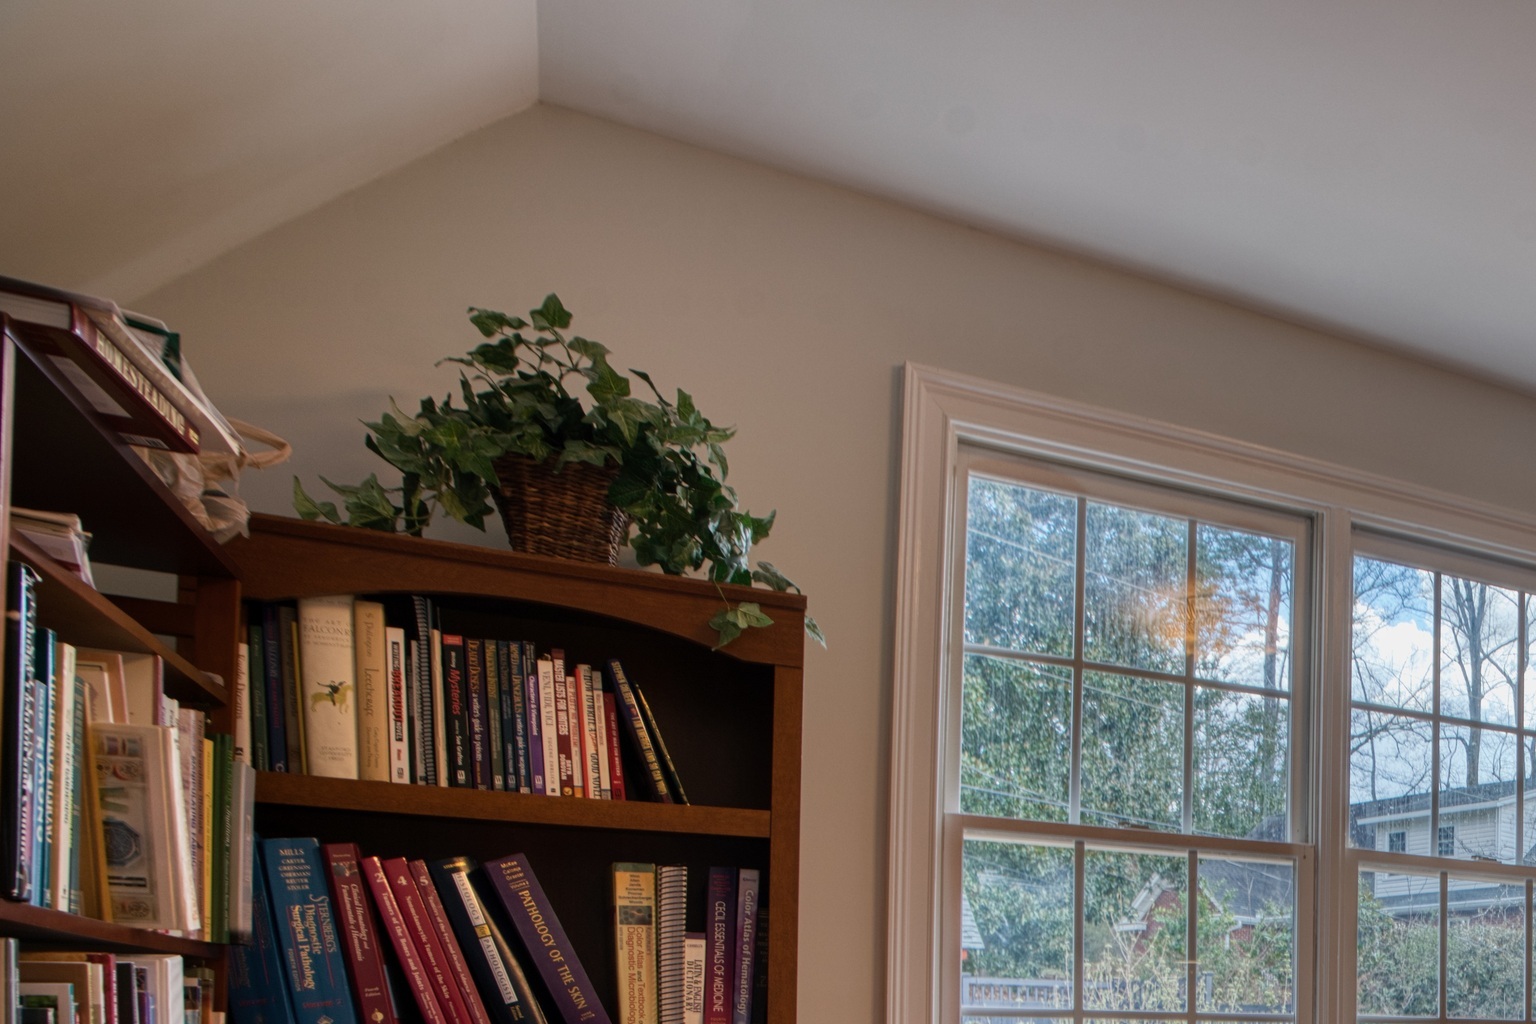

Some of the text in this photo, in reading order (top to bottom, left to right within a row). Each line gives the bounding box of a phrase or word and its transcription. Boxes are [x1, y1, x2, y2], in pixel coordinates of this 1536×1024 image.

[96, 328, 185, 436] HOMESTEADING
[35, 734, 45, 840] KIMONO
[279, 848, 304, 856] MILLS
[375, 872, 384, 882] 2
[397, 876, 408, 886] 4
[420, 876, 428, 886] 5
[290, 905, 316, 990] Surgical Pathology
[304, 903, 322, 955] Diagnostic
[455, 874, 514, 1002] HISTOLOGY for PATHOLOGISTS
[518, 890, 588, 1010] PATHOLOGY OF THE SKIN
[627, 927, 636, 970] Diagnostic
[635, 926, 644, 944] Color
[636, 949, 644, 968] Atlas
[694, 959, 703, 978] LATIN
[713, 900, 726, 1013] CECIL ESSENTIALS OF MEDICINE
[736, 890, 754, 1016] Color Atlas of Hematology
[636, 981, 645, 1018] Textbook
[685, 960, 694, 1012] DICTIONARY
[693, 988, 702, 1014] ENGLISH
